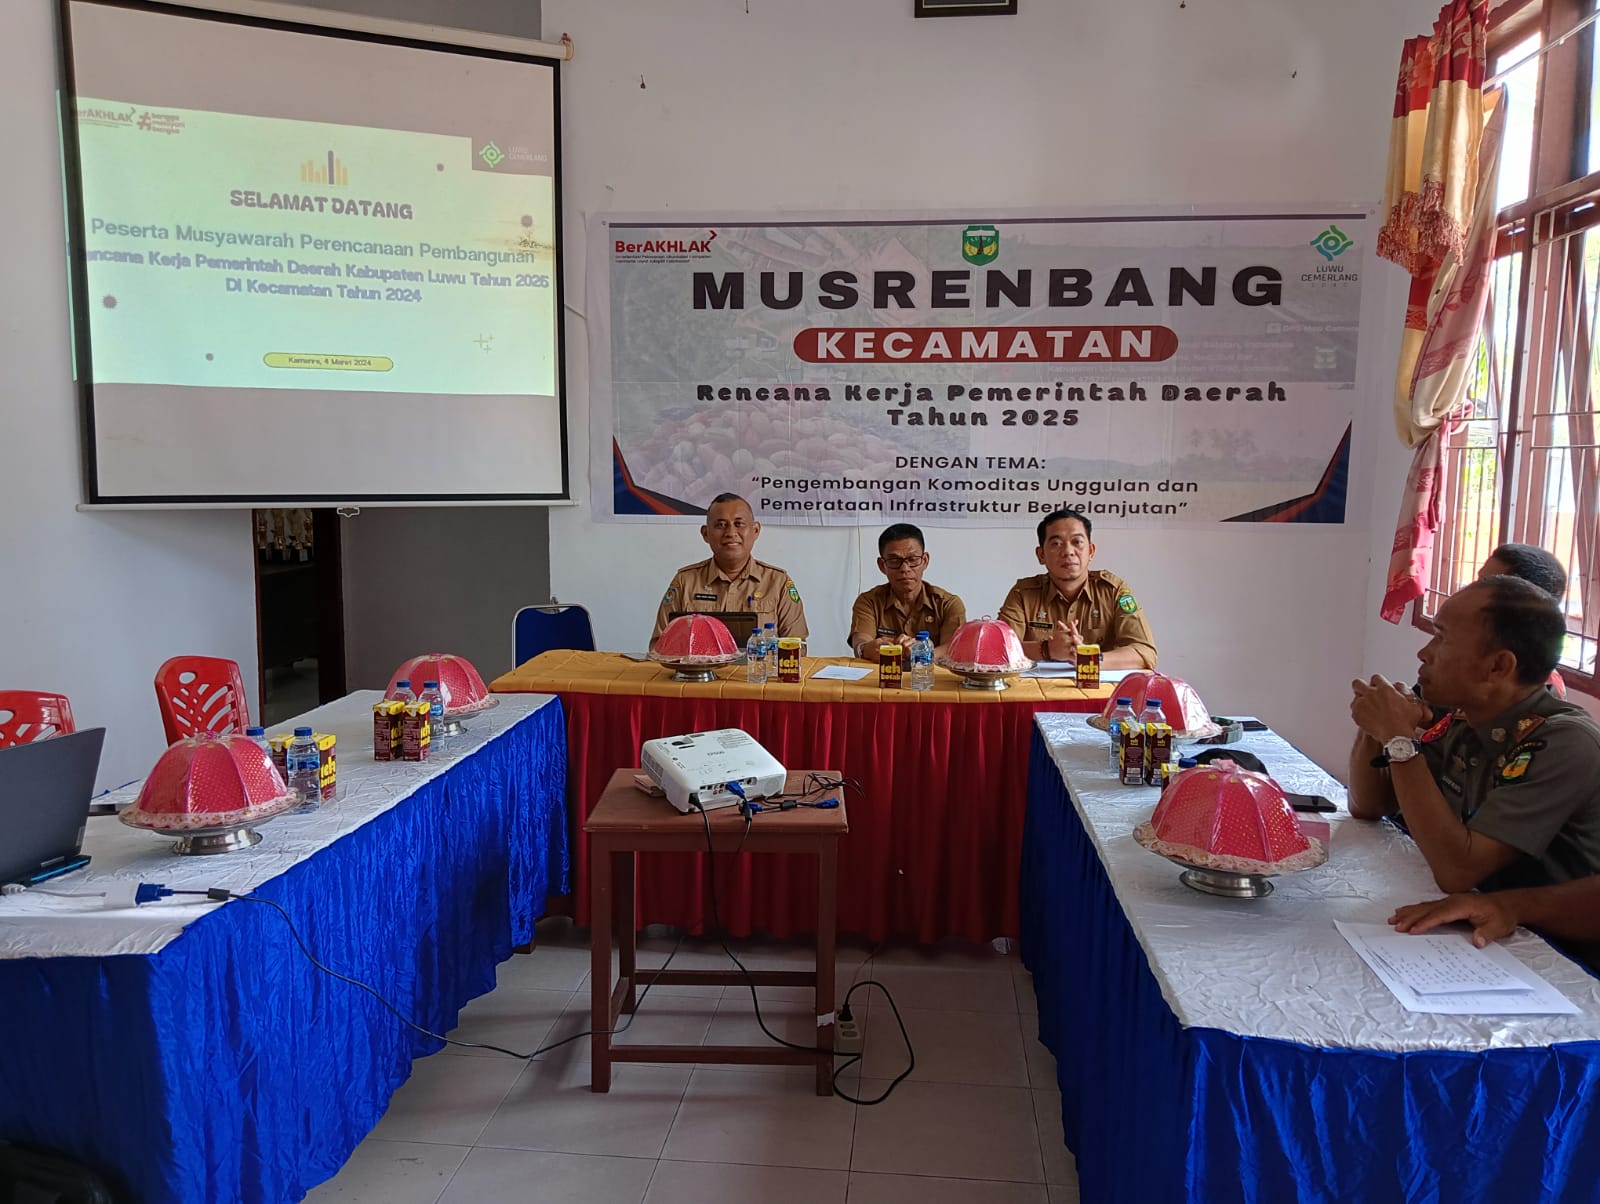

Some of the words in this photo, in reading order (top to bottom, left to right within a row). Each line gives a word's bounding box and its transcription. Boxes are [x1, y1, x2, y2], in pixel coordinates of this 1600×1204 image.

[77, 108, 133, 123] erAKHLAK
[230, 190, 328, 213] SELAMAT
[331, 198, 414, 220] DATANG
[91, 218, 169, 240] Peserta
[176, 225, 294, 249] Musyawarah
[300, 233, 413, 257] Perencanaan
[420, 243, 535, 267] Pembangunan
[615, 240, 711, 253] BerAKHLAK
[86, 250, 144, 265] encana
[148, 251, 192, 270] Kerja
[195, 254, 284, 274] Pemerintah
[288, 260, 341, 277] Daerah
[346, 264, 424, 284] Kabupaten
[428, 268, 466, 285] Luwu
[470, 272, 511, 287] Tahun
[515, 274, 550, 289] 2025
[1301, 273, 1358, 282] CEMERLANG
[1316, 265, 1344, 273] LUWU
[247, 280, 332, 298] Kecamatan
[337, 284, 381, 300] Tahun
[386, 287, 422, 303] 2024
[693, 266, 1283, 310] MUSRENBANG
[817, 330, 1152, 359] KECAMATAN
[354, 359, 372, 367] 2024
[697, 384, 831, 402] Rencana
[845, 382, 934, 407] Kerja
[947, 381, 1147, 402] Pemerintah
[1161, 381, 1287, 402] Daerah
[887, 407, 988, 426] Tahun
[1001, 409, 1080, 426] 2025
[895, 456, 979, 469] DENGAN
[986, 457, 1047, 470] TEMA:
[751, 476, 921, 493] “Pengembangan
[928, 477, 1040, 491] Komoditas
[1047, 479, 1150, 496] Unggulan
[1157, 479, 1199, 493] dan
[760, 498, 884, 512] Pemerataan
[890, 498, 1021, 514] Infrastruktur
[1027, 501, 1188, 518] Berkelanjutan”
[779, 655, 799, 668] teh
[881, 661, 901, 673] teh
[1078, 660, 1099, 673] teh
